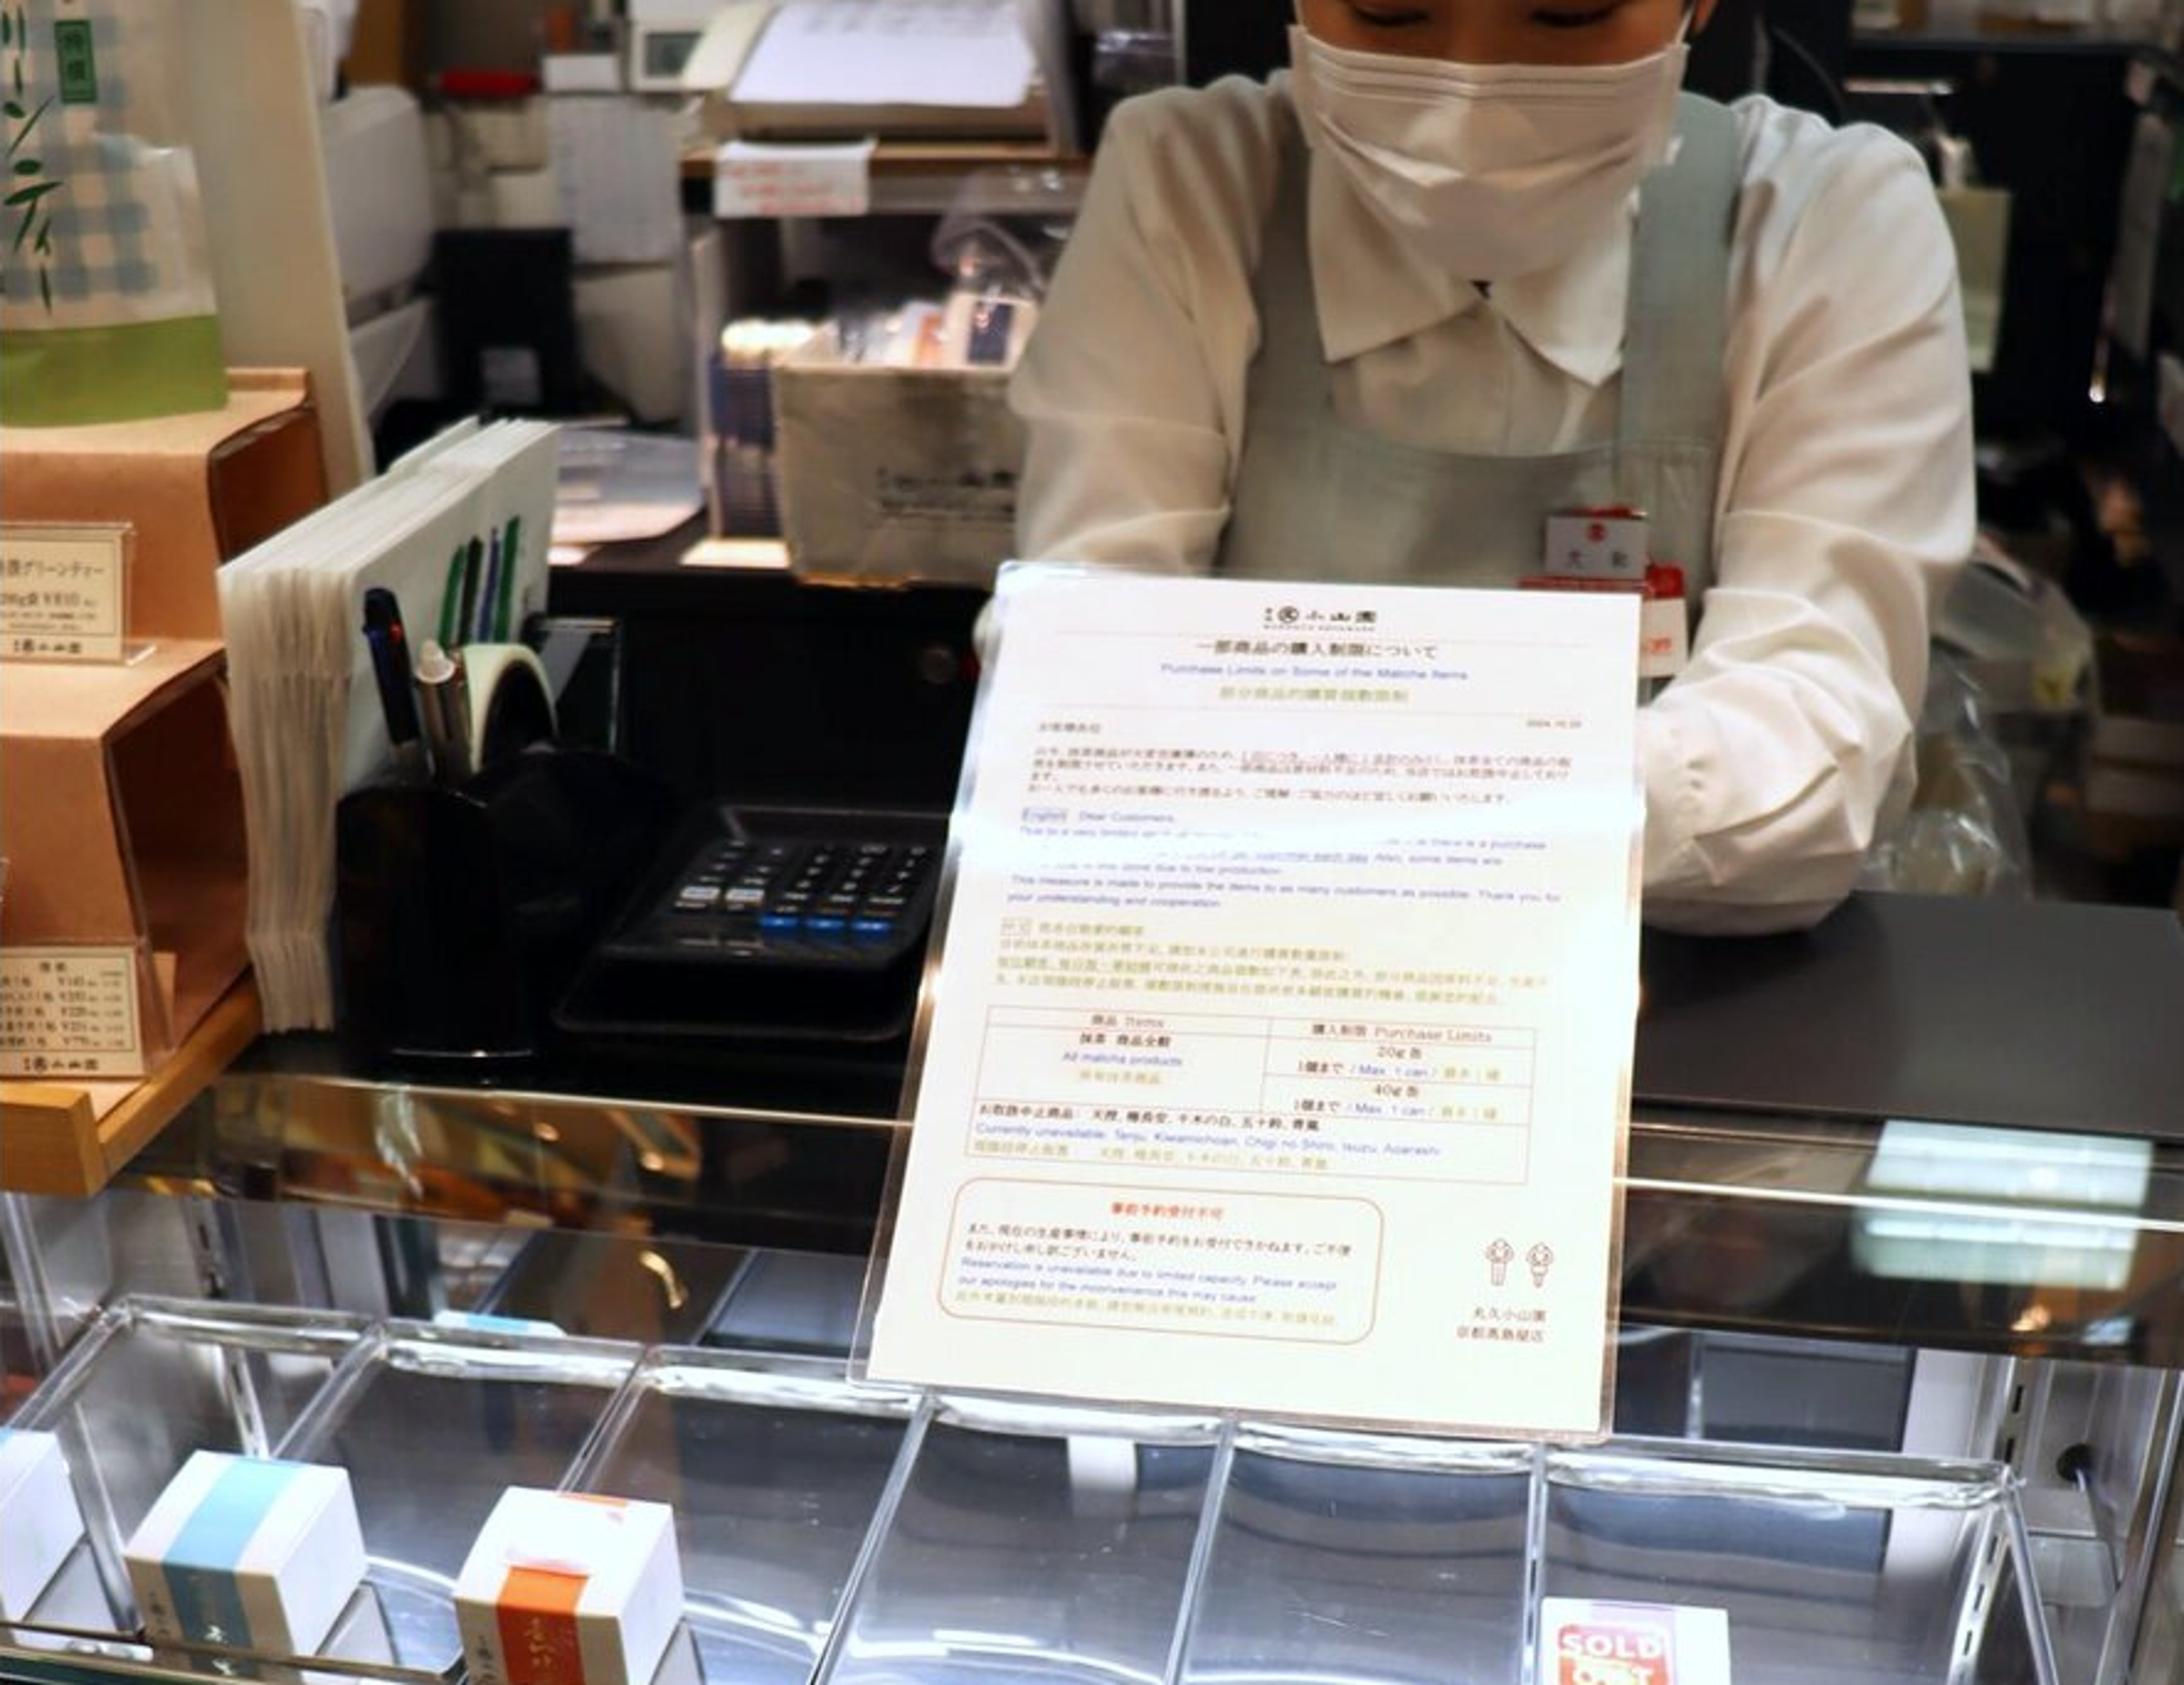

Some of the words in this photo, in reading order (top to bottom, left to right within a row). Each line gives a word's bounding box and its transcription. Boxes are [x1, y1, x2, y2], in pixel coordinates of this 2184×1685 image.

[1161, 663, 1223, 675] Purchase
[1228, 664, 1266, 676] Limits
[1270, 668, 1289, 676] on
[1292, 666, 1330, 678] Some
[1335, 667, 1350, 678] of
[1352, 667, 1372, 678] the
[1378, 669, 1427, 680] Matcha
[1431, 671, 1468, 681] Items
[1375, 1025, 1442, 1041] Purchase
[1448, 1029, 1492, 1043] Limits
[976, 1123, 1033, 1137] Currently
[961, 1256, 1030, 1272] Reservation
[1047, 1263, 1112, 1276] unavailable
[1252, 1275, 1293, 1287] Please
[981, 1276, 1036, 1291] apologies
[1561, 1633, 1663, 1659] SOLD
